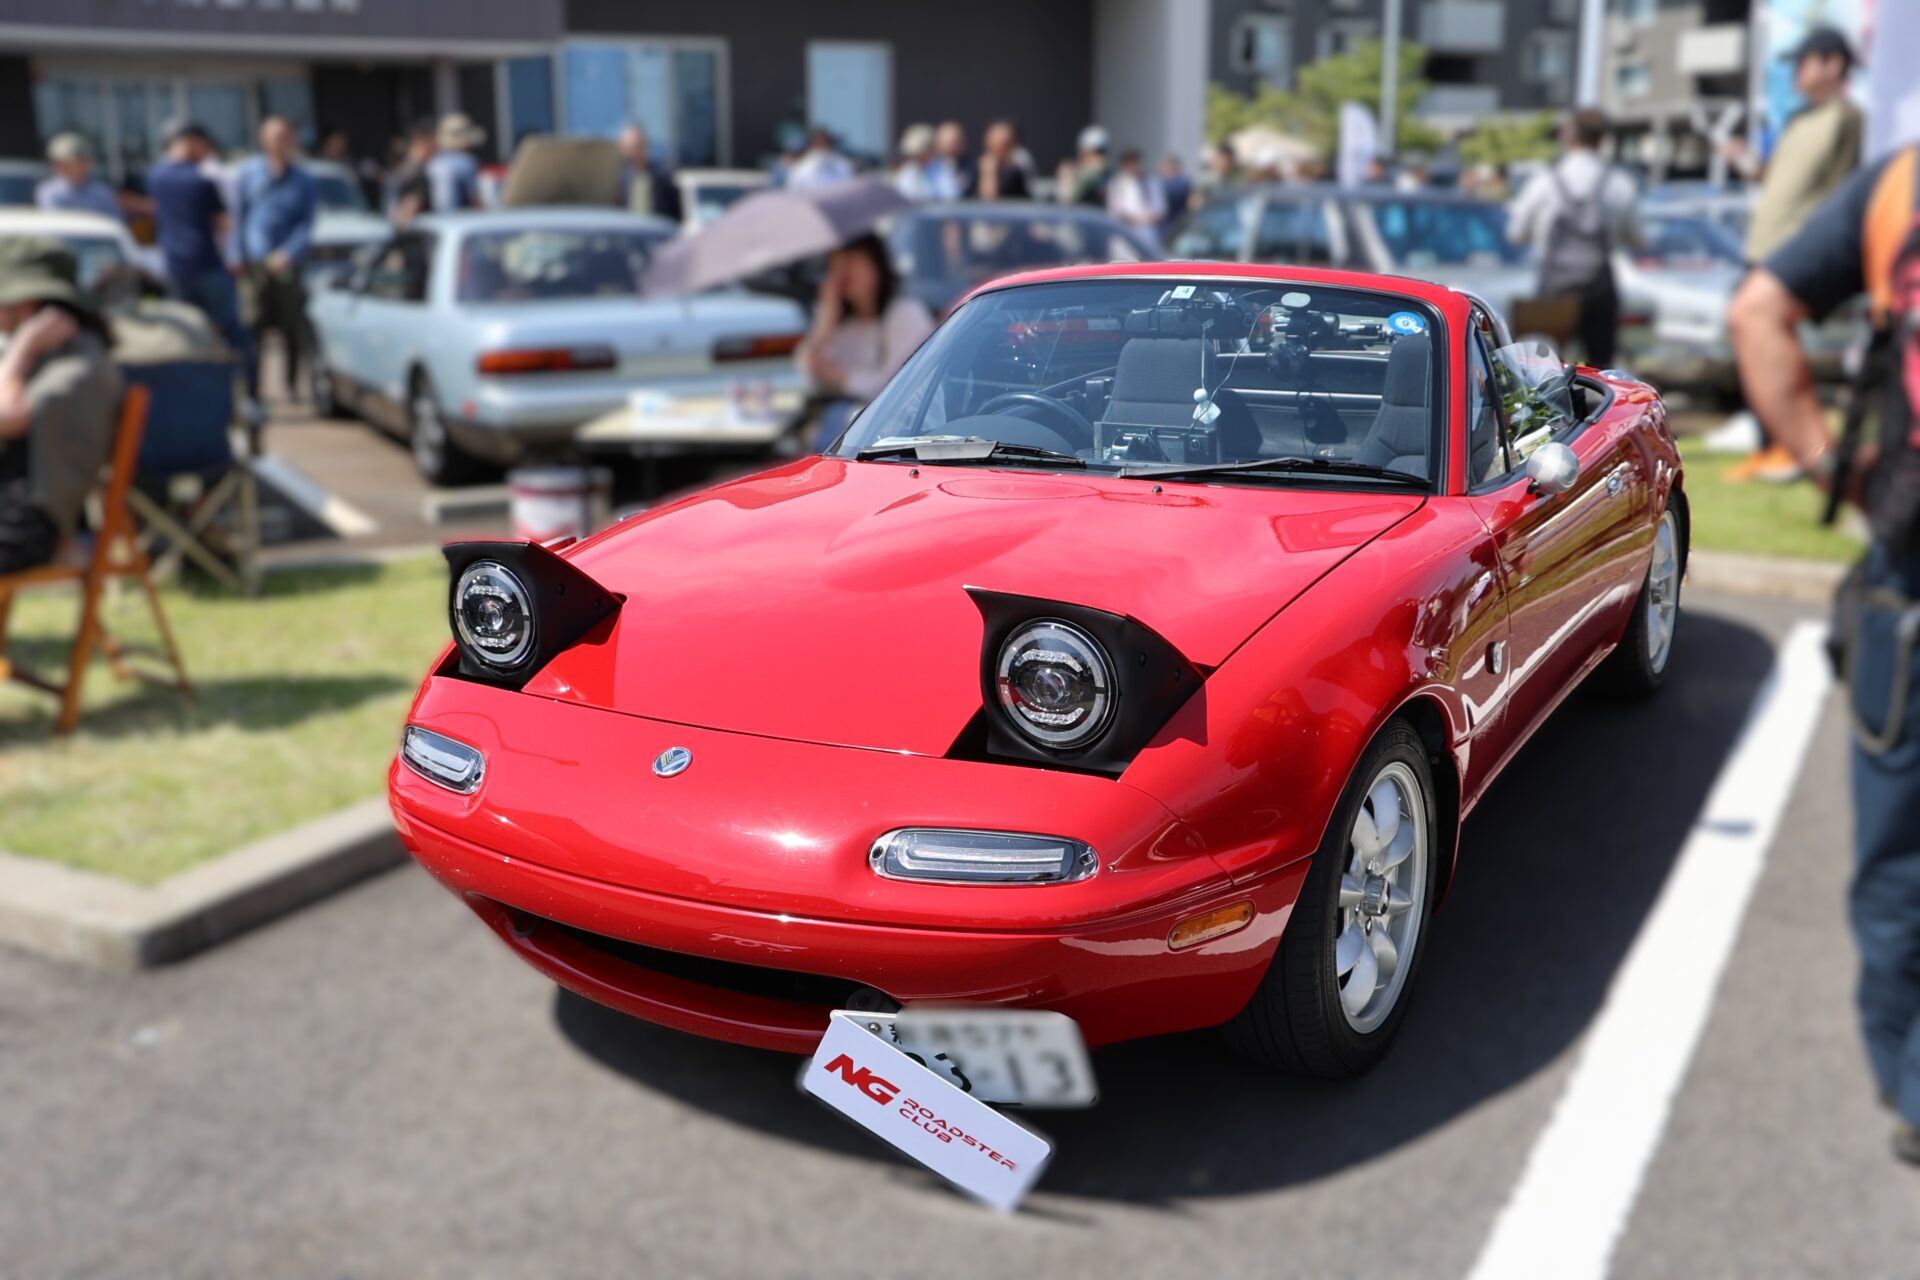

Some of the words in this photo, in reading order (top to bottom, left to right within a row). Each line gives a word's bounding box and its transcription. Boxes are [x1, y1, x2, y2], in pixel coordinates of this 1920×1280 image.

[823, 1053, 901, 1105] NG
[898, 1107, 953, 1145] CLUB
[903, 1097, 1018, 1172] ROADSTER
